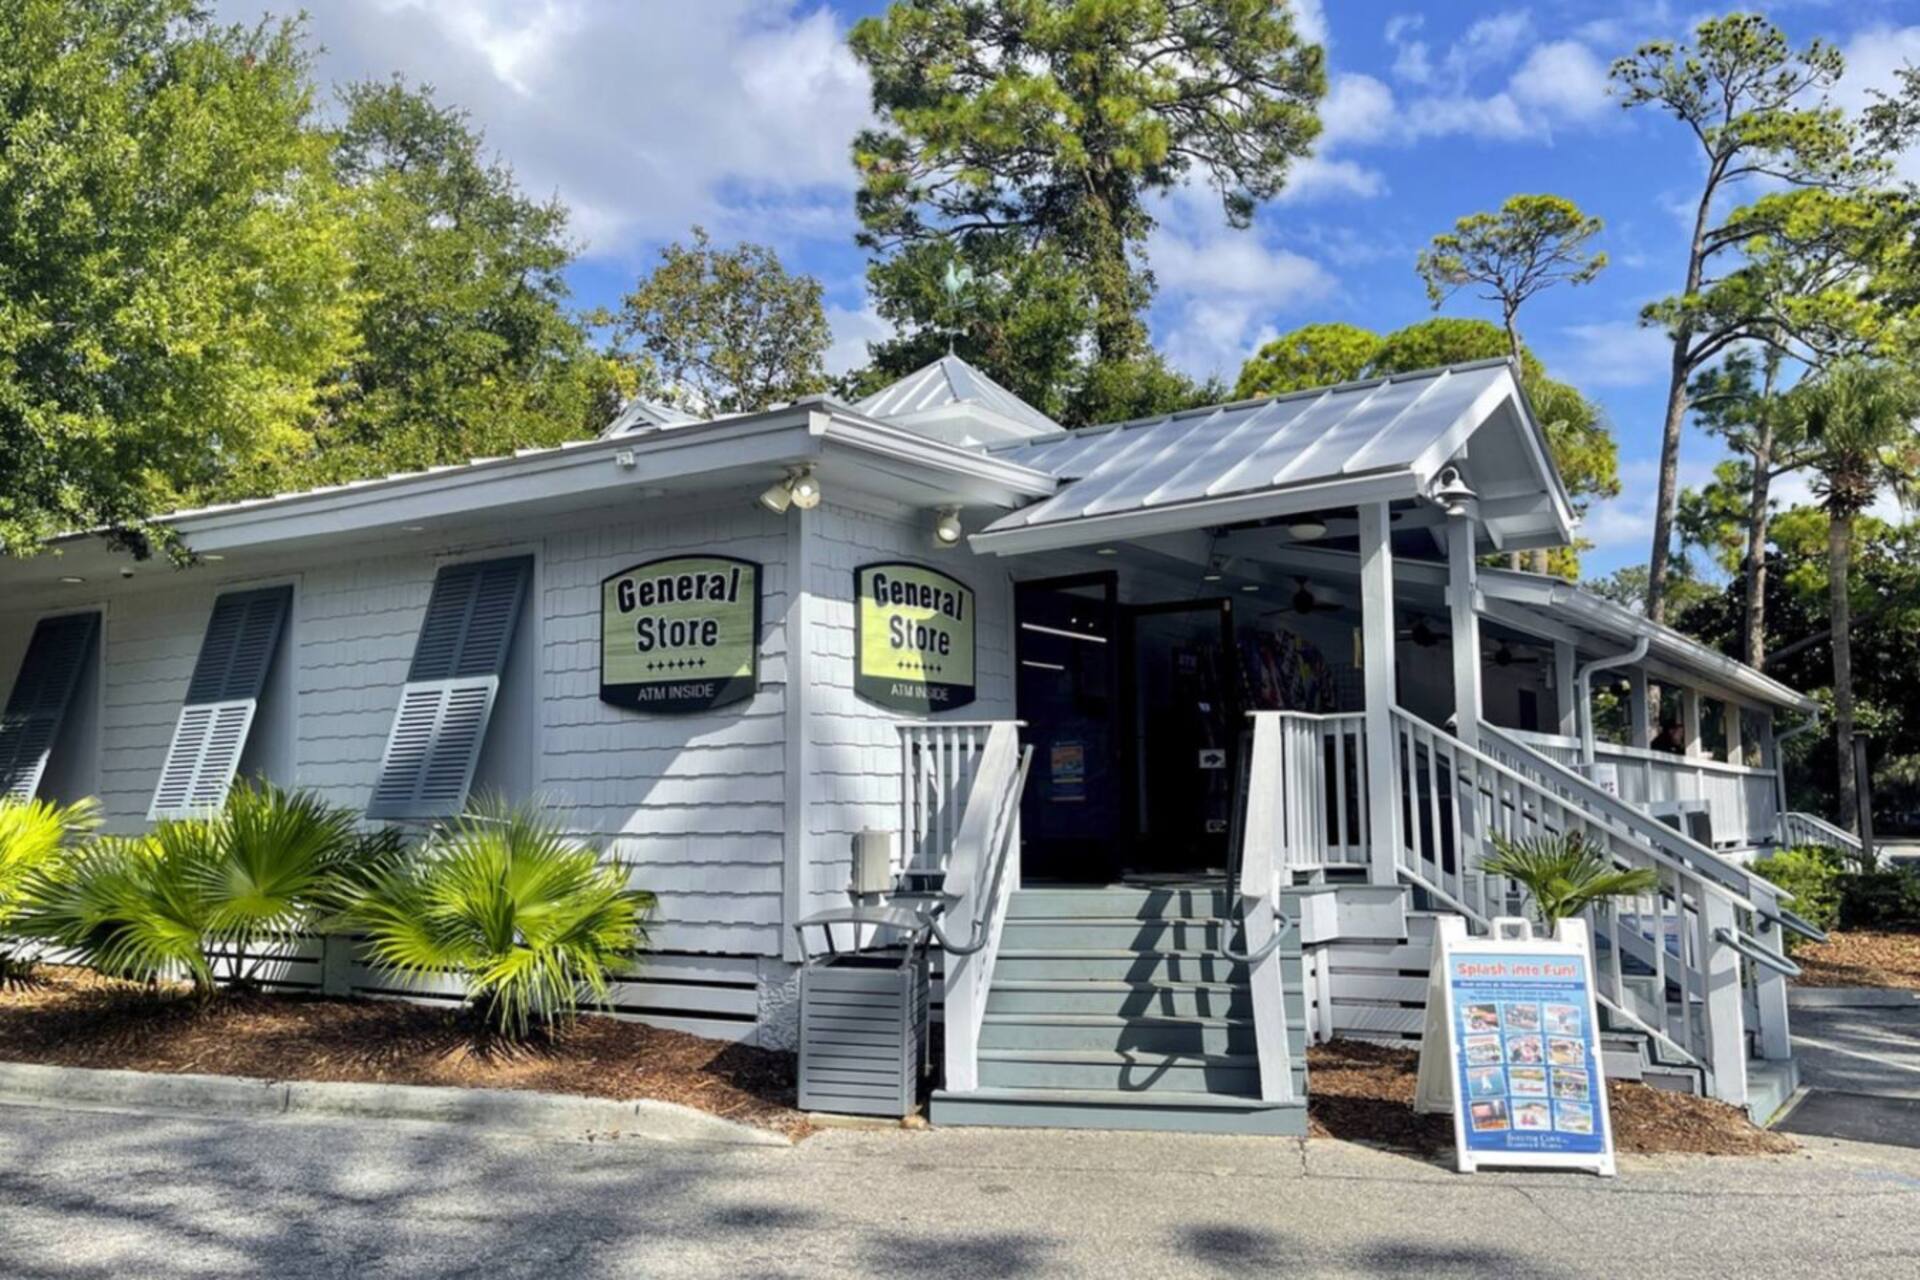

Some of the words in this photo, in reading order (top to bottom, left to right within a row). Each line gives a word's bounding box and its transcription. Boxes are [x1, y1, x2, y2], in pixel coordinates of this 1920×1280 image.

[617, 567, 740, 613] General
[873, 572, 964, 621] General
[637, 617, 718, 652] Store
[889, 614, 950, 656] Store
[638, 686, 666, 701] ATM
[669, 683, 715, 698] INSIDE
[891, 683, 913, 697] ATM
[915, 685, 949, 701] INSIDE
[1457, 961, 1507, 977] Splash
[1512, 962, 1539, 976] into
[1543, 963, 1576, 976] Fun!
